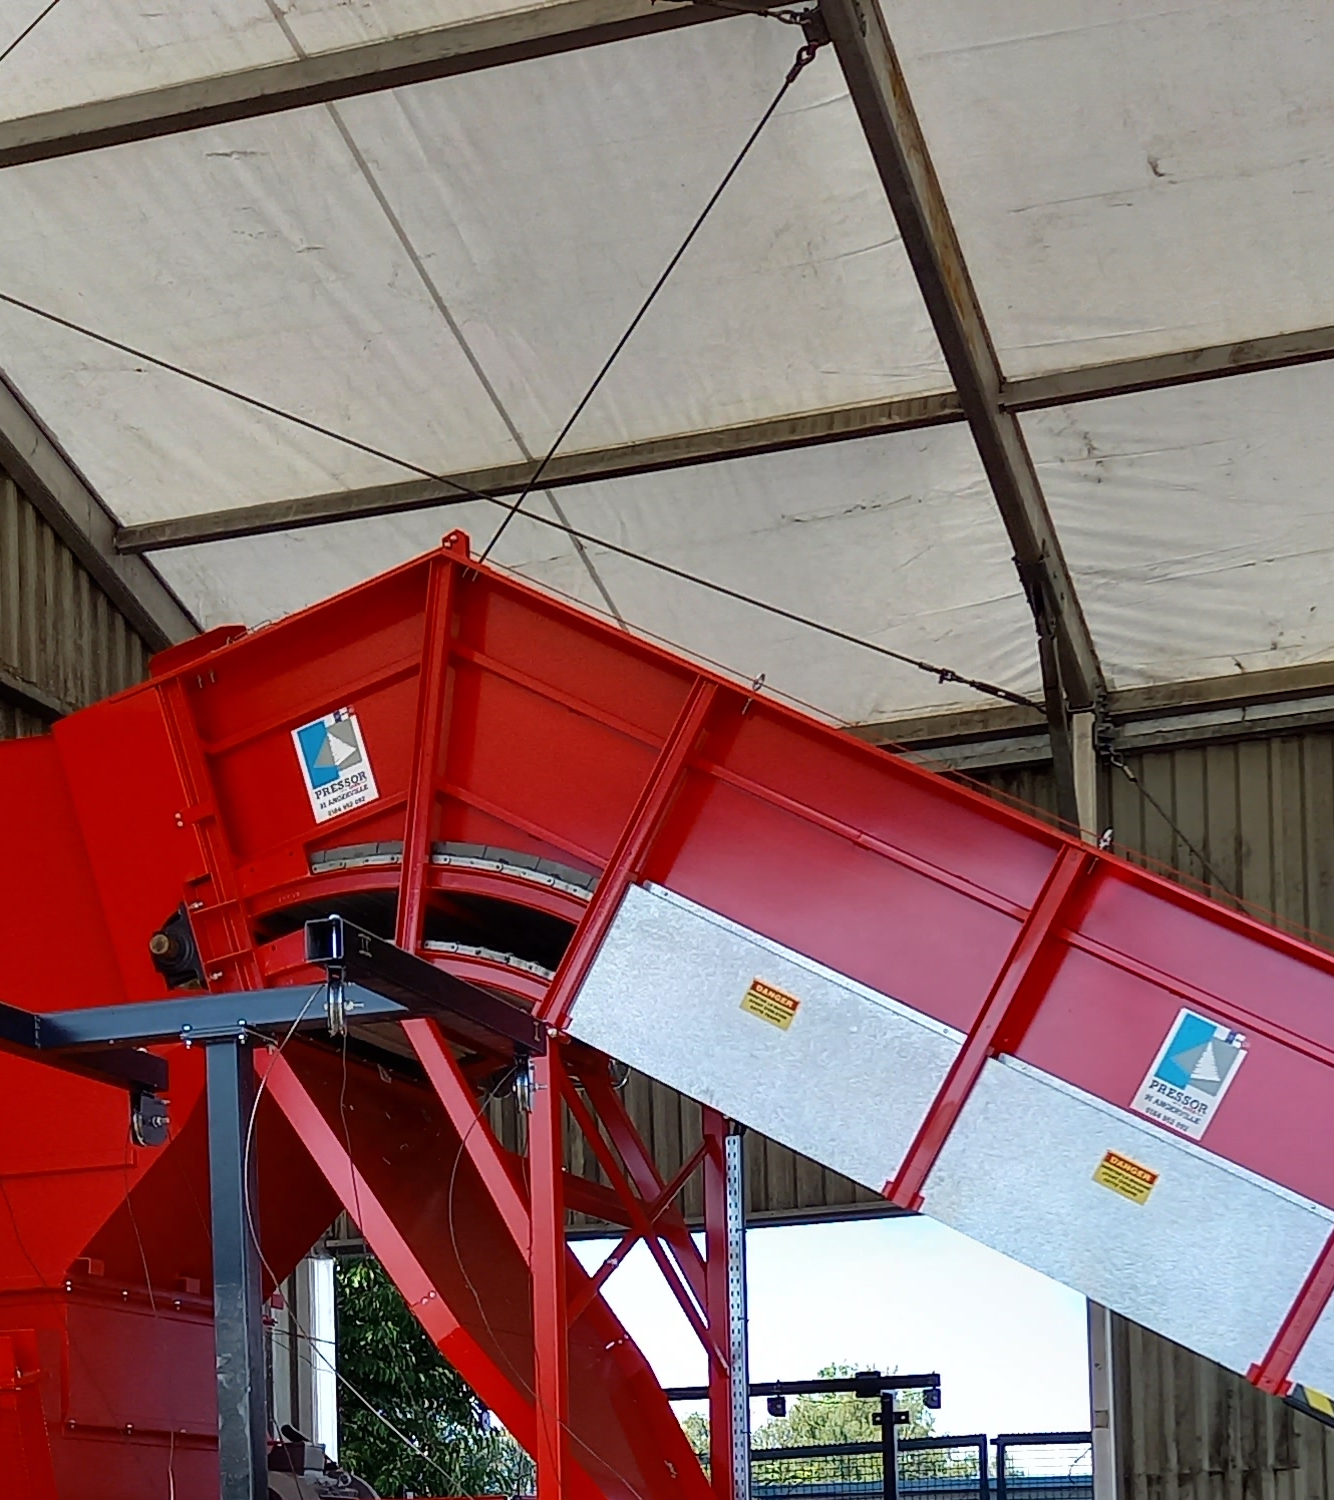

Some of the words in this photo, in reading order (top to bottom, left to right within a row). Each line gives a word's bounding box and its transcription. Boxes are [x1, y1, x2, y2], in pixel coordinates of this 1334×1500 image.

[314, 770, 367, 800] PRESSOR
[756, 984, 794, 1008] DANGER
[1148, 1080, 1209, 1115] PRESSOR
[1109, 1155, 1152, 1182] DANGER
